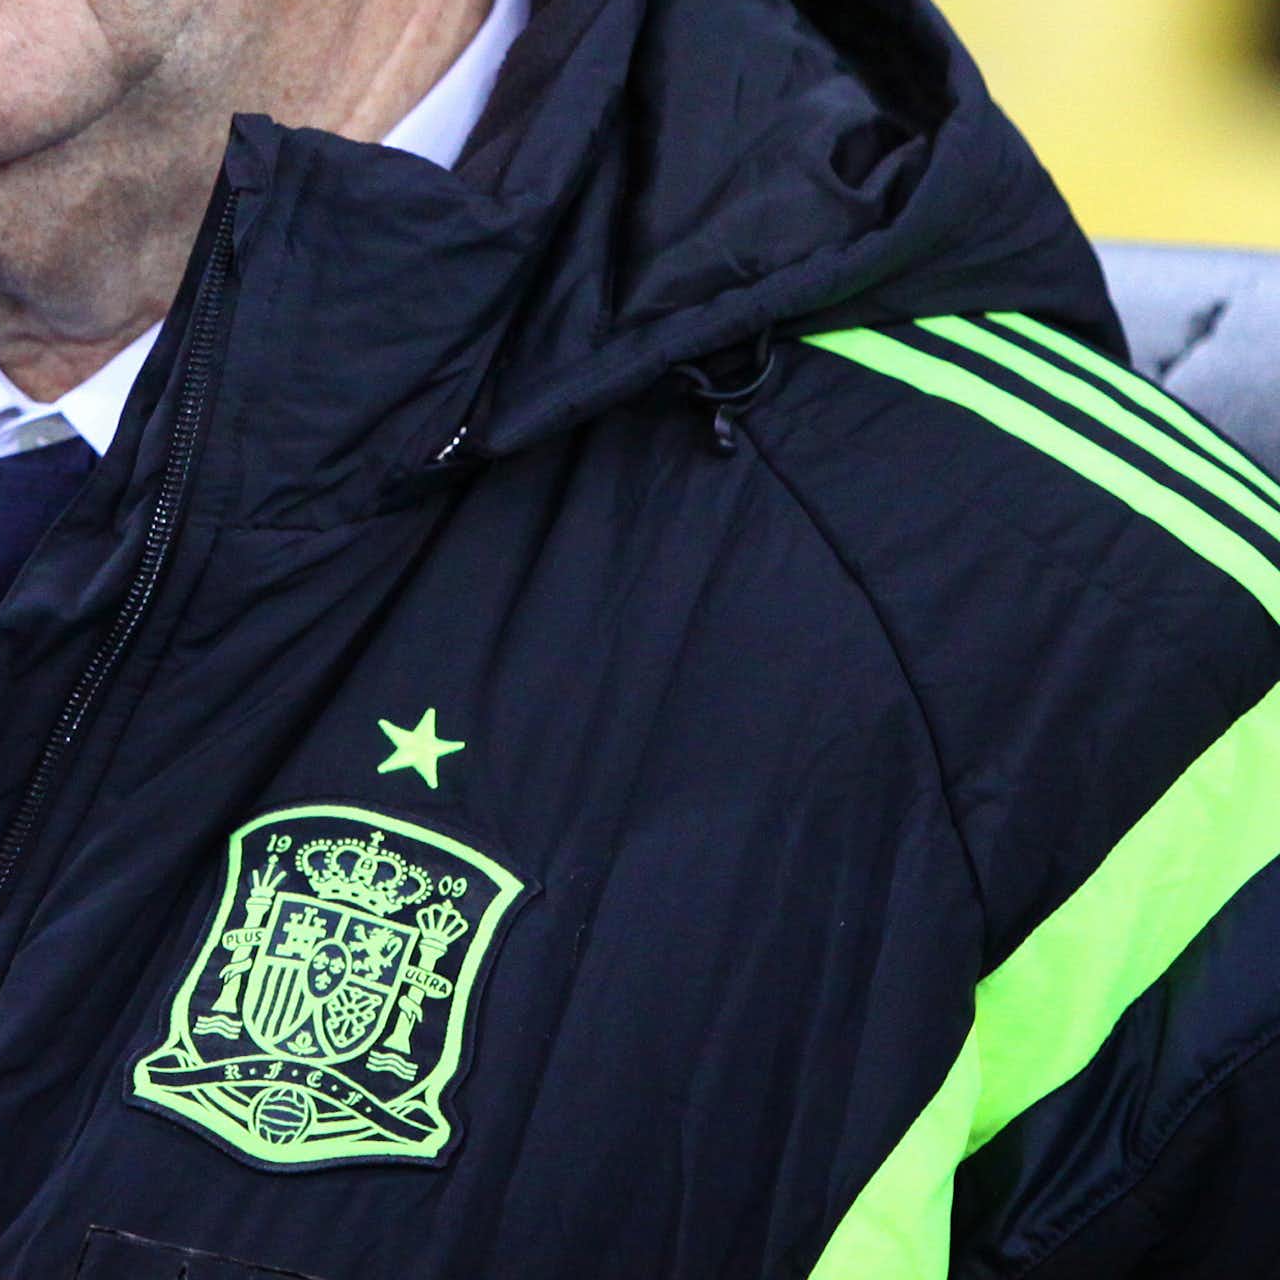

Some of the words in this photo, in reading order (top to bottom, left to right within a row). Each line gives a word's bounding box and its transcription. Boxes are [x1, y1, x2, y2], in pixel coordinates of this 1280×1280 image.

[267, 833, 293, 853] 19
[438, 874, 468, 898] 09
[226, 930, 262, 946] PLUS
[405, 969, 447, 995] ULTRA
